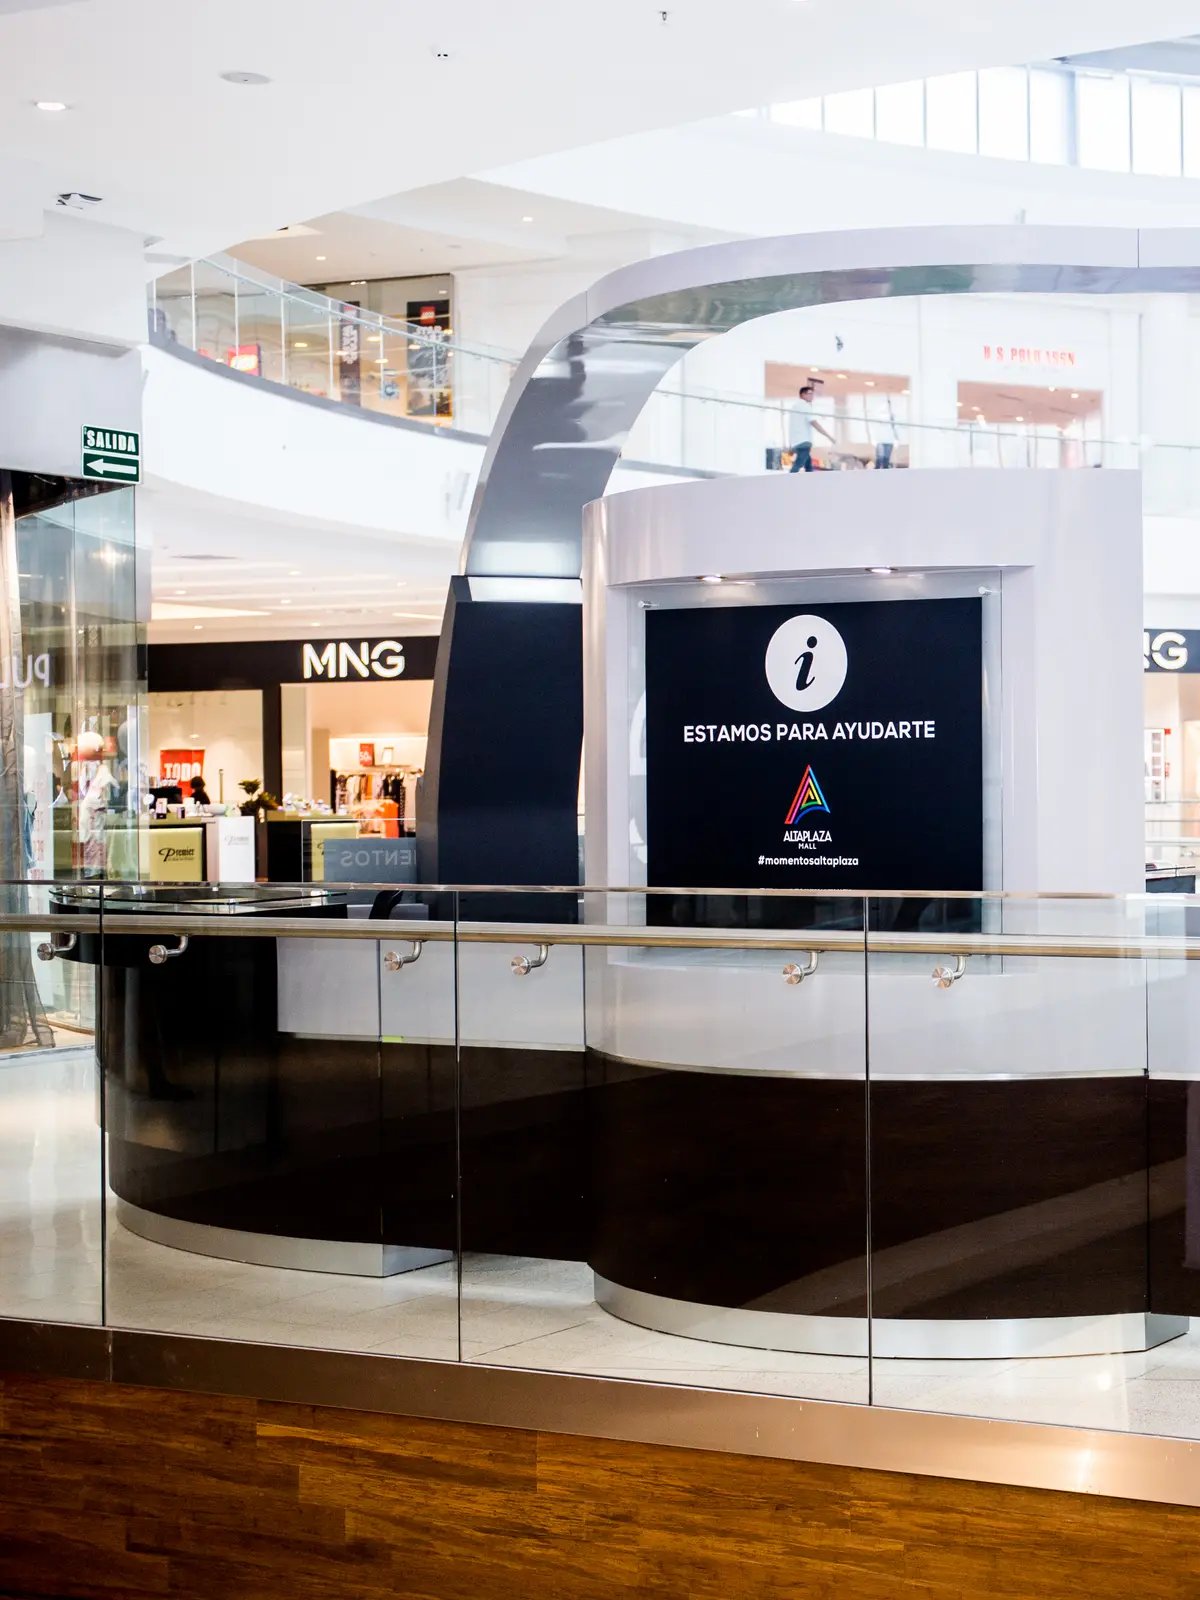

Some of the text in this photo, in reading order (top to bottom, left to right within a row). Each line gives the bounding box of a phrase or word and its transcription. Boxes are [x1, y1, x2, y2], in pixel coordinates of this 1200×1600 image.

[86, 430, 137, 453] SALIDA
[302, 640, 406, 679] MNG
[1143, 631, 1188, 670] G
[683, 720, 936, 742] ESTAMOS PARA AYUDARTE
[164, 762, 202, 782] TODO
[783, 830, 832, 842] ALTAPLAZA
[758, 855, 859, 868] #momentosaltaplaza
